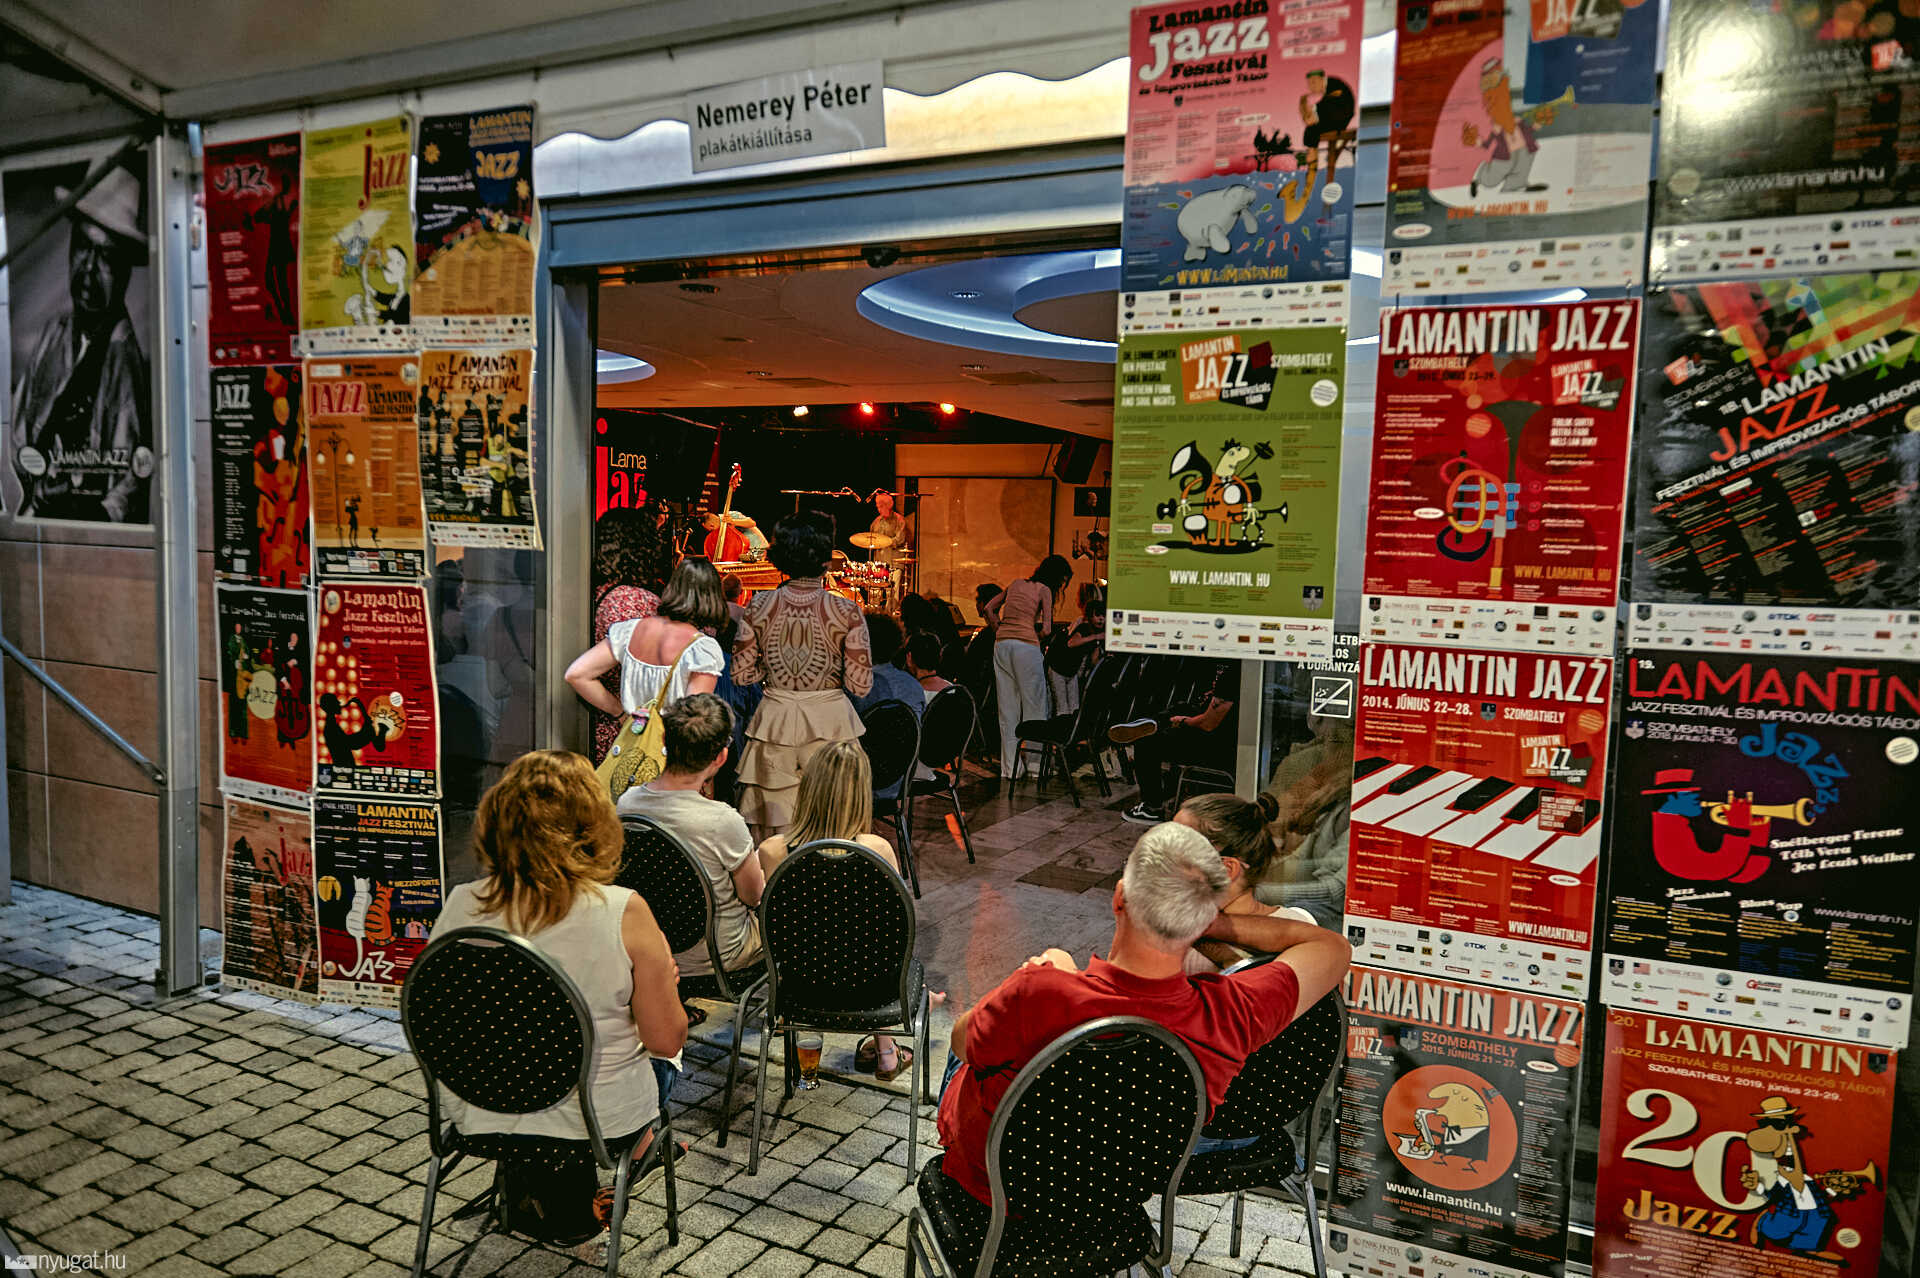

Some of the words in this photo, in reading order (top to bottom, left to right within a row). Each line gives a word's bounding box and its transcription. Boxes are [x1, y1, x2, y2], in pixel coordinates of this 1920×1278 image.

[1149, 0, 1269, 33] Lamantin
[1138, 16, 1270, 82] Jazz
[1171, 53, 1267, 79] Fesztivál
[696, 93, 796, 129] Nemerey
[803, 79, 871, 112] Péter
[469, 110, 531, 130] LAMANTIN
[700, 127, 812, 162] plakátkiállítása
[475, 150, 520, 179] JAZZ
[1381, 309, 1540, 355] LAMANTIN
[1551, 304, 1633, 351] JAZZ
[1182, 335, 1235, 363] LAMANTIN
[1270, 352, 1333, 368] SZOMBATHELY
[1195, 354, 1249, 390] JAZZ
[1409, 356, 1468, 370] SZOMBATHELY
[1741, 336, 1890, 414] LAMANTIN
[1562, 372, 1603, 396] JAZZ
[215, 383, 253, 412] JAZZ
[309, 382, 367, 420] JAZZ
[1709, 383, 1841, 462] JAZZ
[609, 446, 648, 470] Lama
[1656, 465, 1731, 500] FESZTIVÁL
[1729, 453, 1752, 470] ÉS
[1750, 404, 1869, 461] IMPROVIZÁCIÓS
[1169, 570, 1200, 585] WWW.
[1203, 571, 1253, 587] LAMANTIN.
[1256, 573, 1270, 587] HU
[343, 590, 422, 610] Lamantin
[1362, 647, 1518, 698] LAMANTIN
[1529, 658, 1608, 704] JAZZ
[1638, 660, 1655, 670] 19.
[1628, 657, 1920, 715] LAMANTIN
[1362, 695, 1393, 709] 2014.
[1395, 693, 1430, 712] JÚNIUS
[1626, 701, 1661, 713] JAZZ
[1661, 702, 1733, 718] FESZTIVÁL
[1734, 706, 1756, 719] ÉS
[1756, 709, 1873, 729] IMPROVIZÁCIÓS
[1503, 707, 1566, 725] SZOMBATHELY
[1647, 721, 1737, 737] SZOMBATHELY
[1520, 735, 1561, 748] LAMANTIN
[1530, 746, 1572, 770] JAZZ
[357, 804, 435, 820] LAMANTIN
[357, 818, 381, 827] JAZZ
[382, 819, 437, 831] FESZTIVÁL
[1852, 827, 1904, 841] Ferenc
[1816, 846, 1852, 857] Vera
[1791, 861, 1816, 874] Joe
[1812, 907, 1913, 926] www.lamantin.hu
[1508, 919, 1588, 944] WWW.LAMANTIN.HU
[337, 950, 396, 981] JAZZ
[1342, 970, 1494, 1033] LAMANTIN
[1503, 996, 1580, 1047] JAZZ
[1613, 1014, 1638, 1028] 20.
[1353, 1036, 1384, 1056] JAZZ
[1421, 1031, 1519, 1058] SZOMBATHELY
[1447, 1047, 1481, 1062] JÚNIUS
[1645, 1019, 1863, 1077] LAMANTIN
[1611, 1046, 1642, 1060] JAZZ
[1644, 1050, 1708, 1070] FESZTIVÁL
[1711, 1062, 1729, 1072] ÉS
[1731, 1064, 1836, 1090] IMPROVIZÁCIÓS
[1840, 1081, 1887, 1097] TÁBOR
[1735, 1076, 1765, 1089] 2019.
[1767, 1081, 1802, 1095] június
[1803, 1086, 1843, 1102] 23-29.
[1385, 1180, 1503, 1217] www.lamantin.hu
[1623, 1189, 1739, 1239] Jazz
